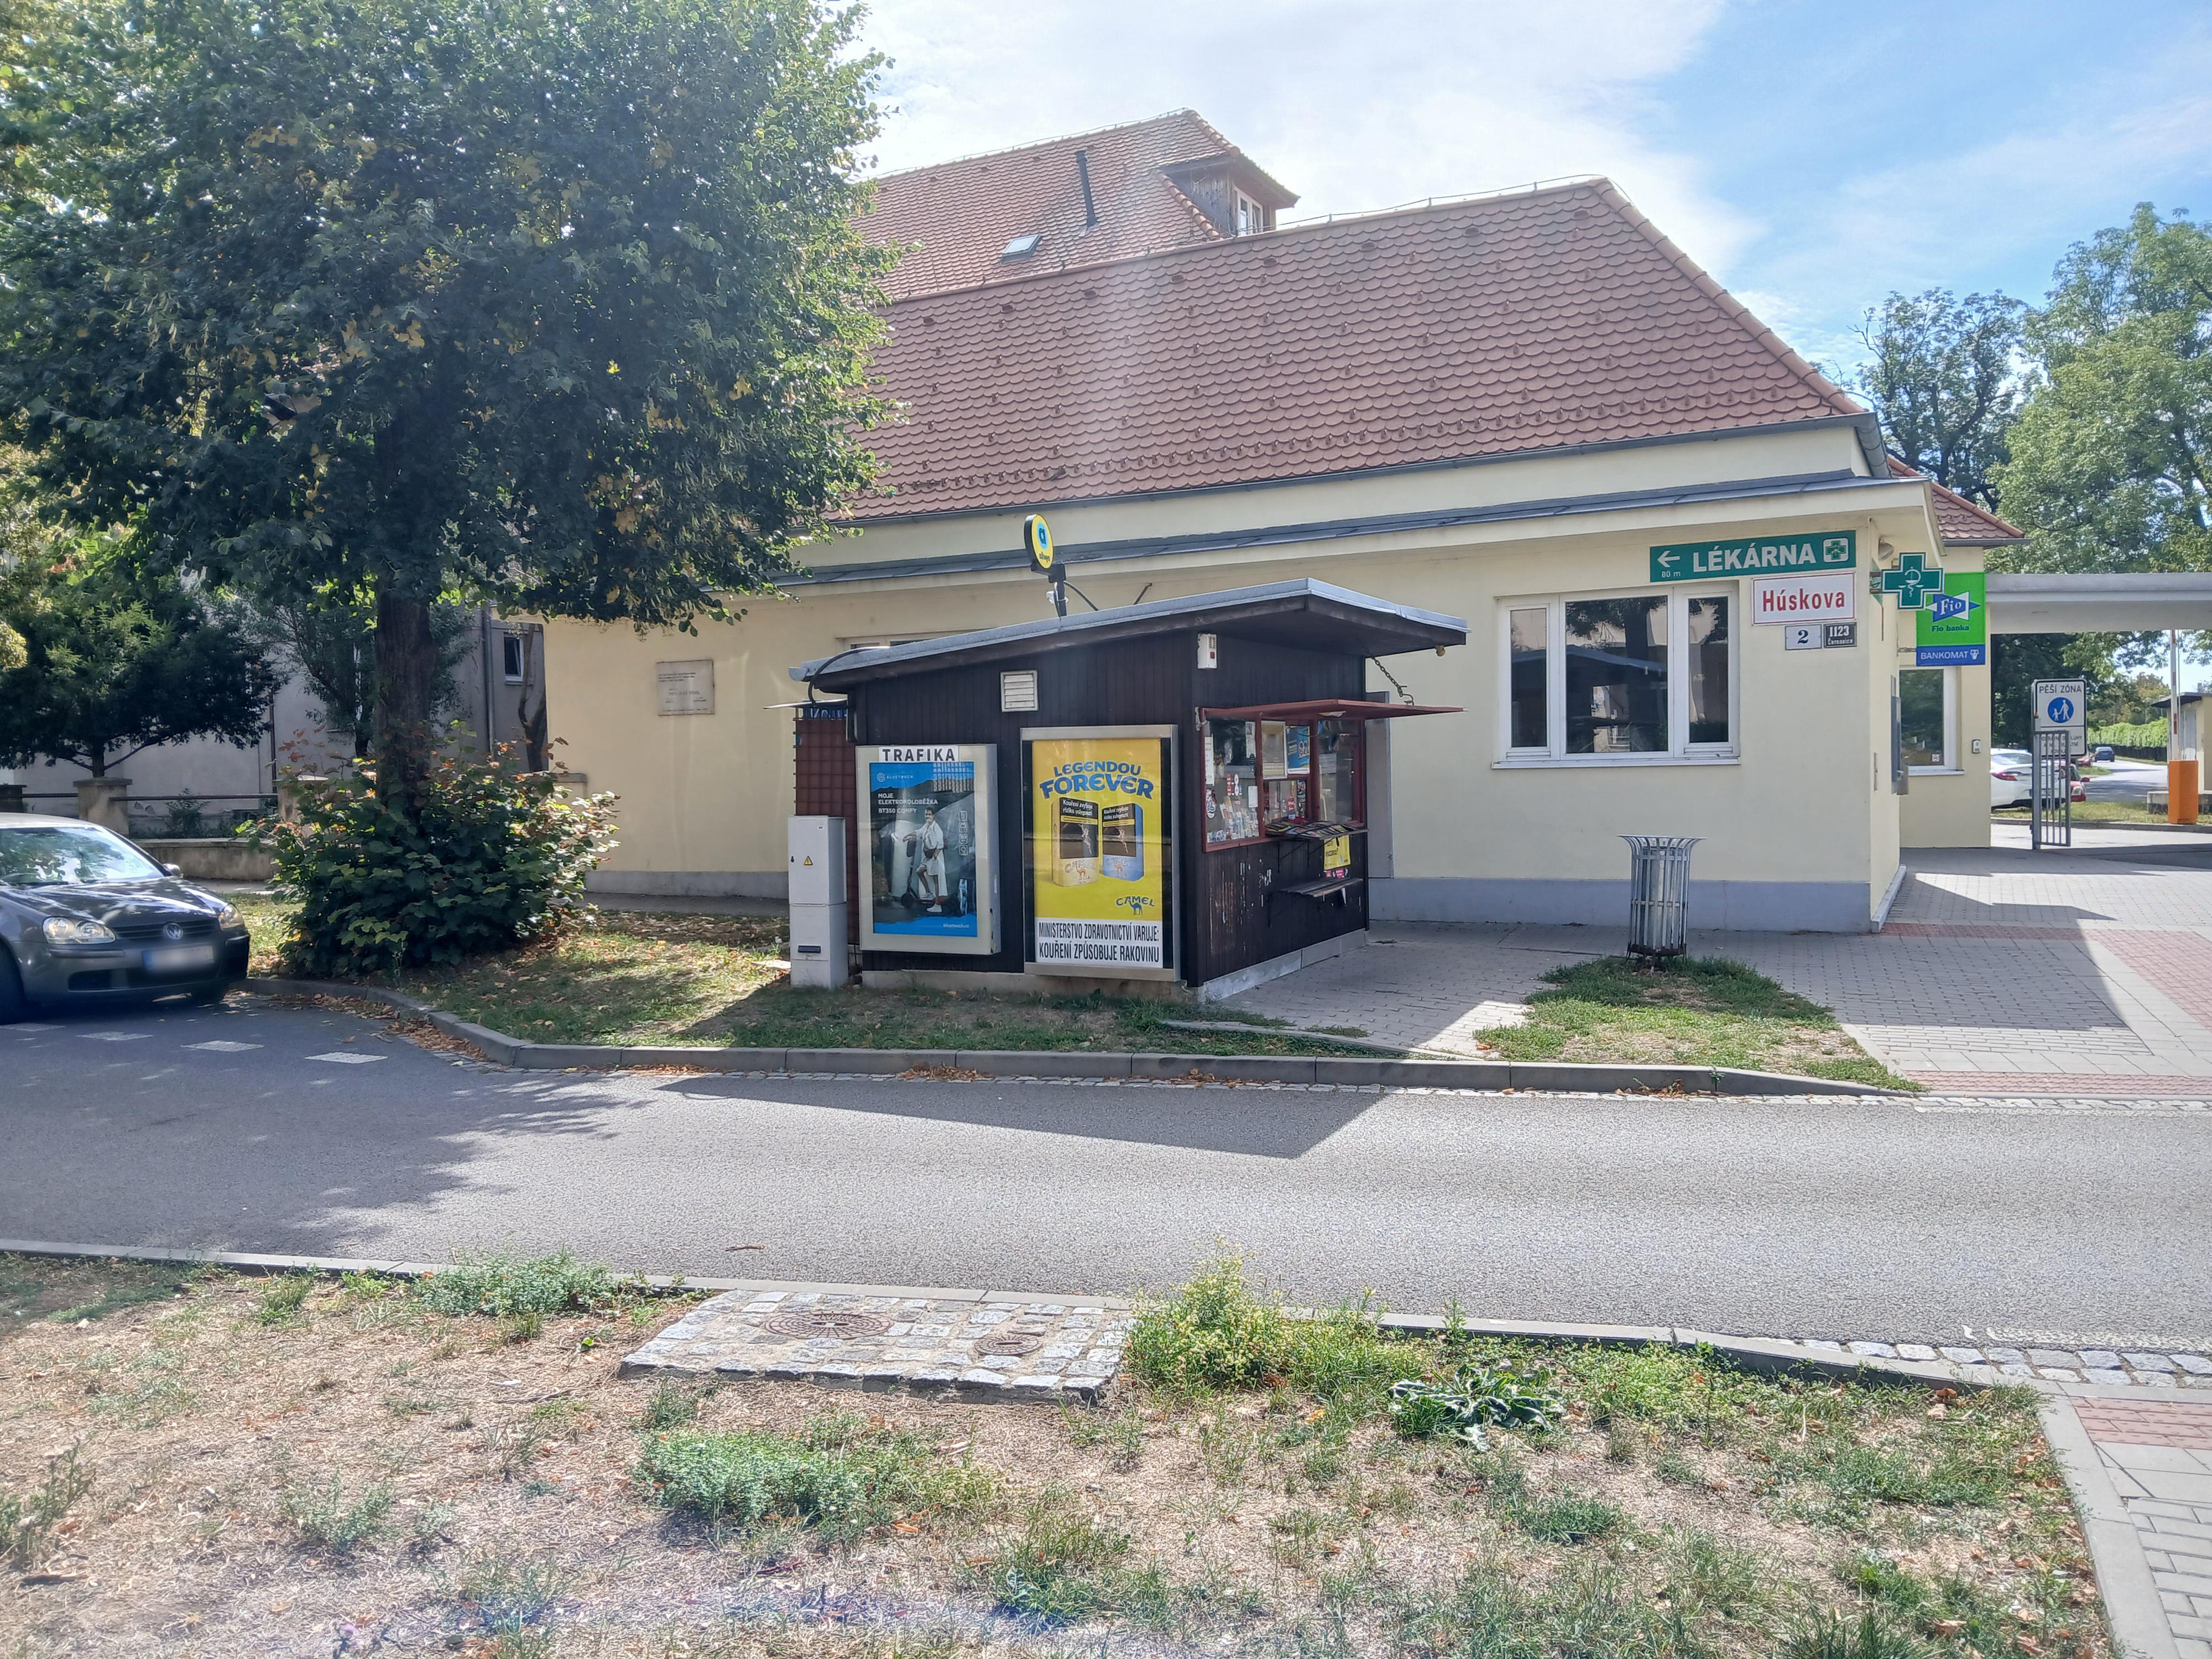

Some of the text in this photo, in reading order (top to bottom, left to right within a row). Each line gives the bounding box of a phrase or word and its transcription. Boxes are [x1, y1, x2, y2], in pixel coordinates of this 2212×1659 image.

[1693, 542, 1817, 572] LÉKÁRNA
[1762, 588, 1845, 612] Húskova
[1940, 598, 1961, 615] Fio
[1797, 630, 1809, 644] 2
[1829, 625, 1849, 637] 1123
[1921, 651, 1968, 660] BANKOMAT
[2039, 684, 2081, 693] PĚŠÍ ZÓNA
[882, 748, 956, 761] TRAFIKA
[1053, 761, 1141, 776] LEGENDOU
[1039, 774, 1154, 800] FOREVER
[1116, 895, 1155, 907] CAMEL
[1039, 922, 1159, 941] MINISTERSTVO ZDRAVOTNICTVÍ VARUJE:
[1039, 941, 1159, 962] KOUŘENÍ ZPŮSOBUJE RAKOVINU
